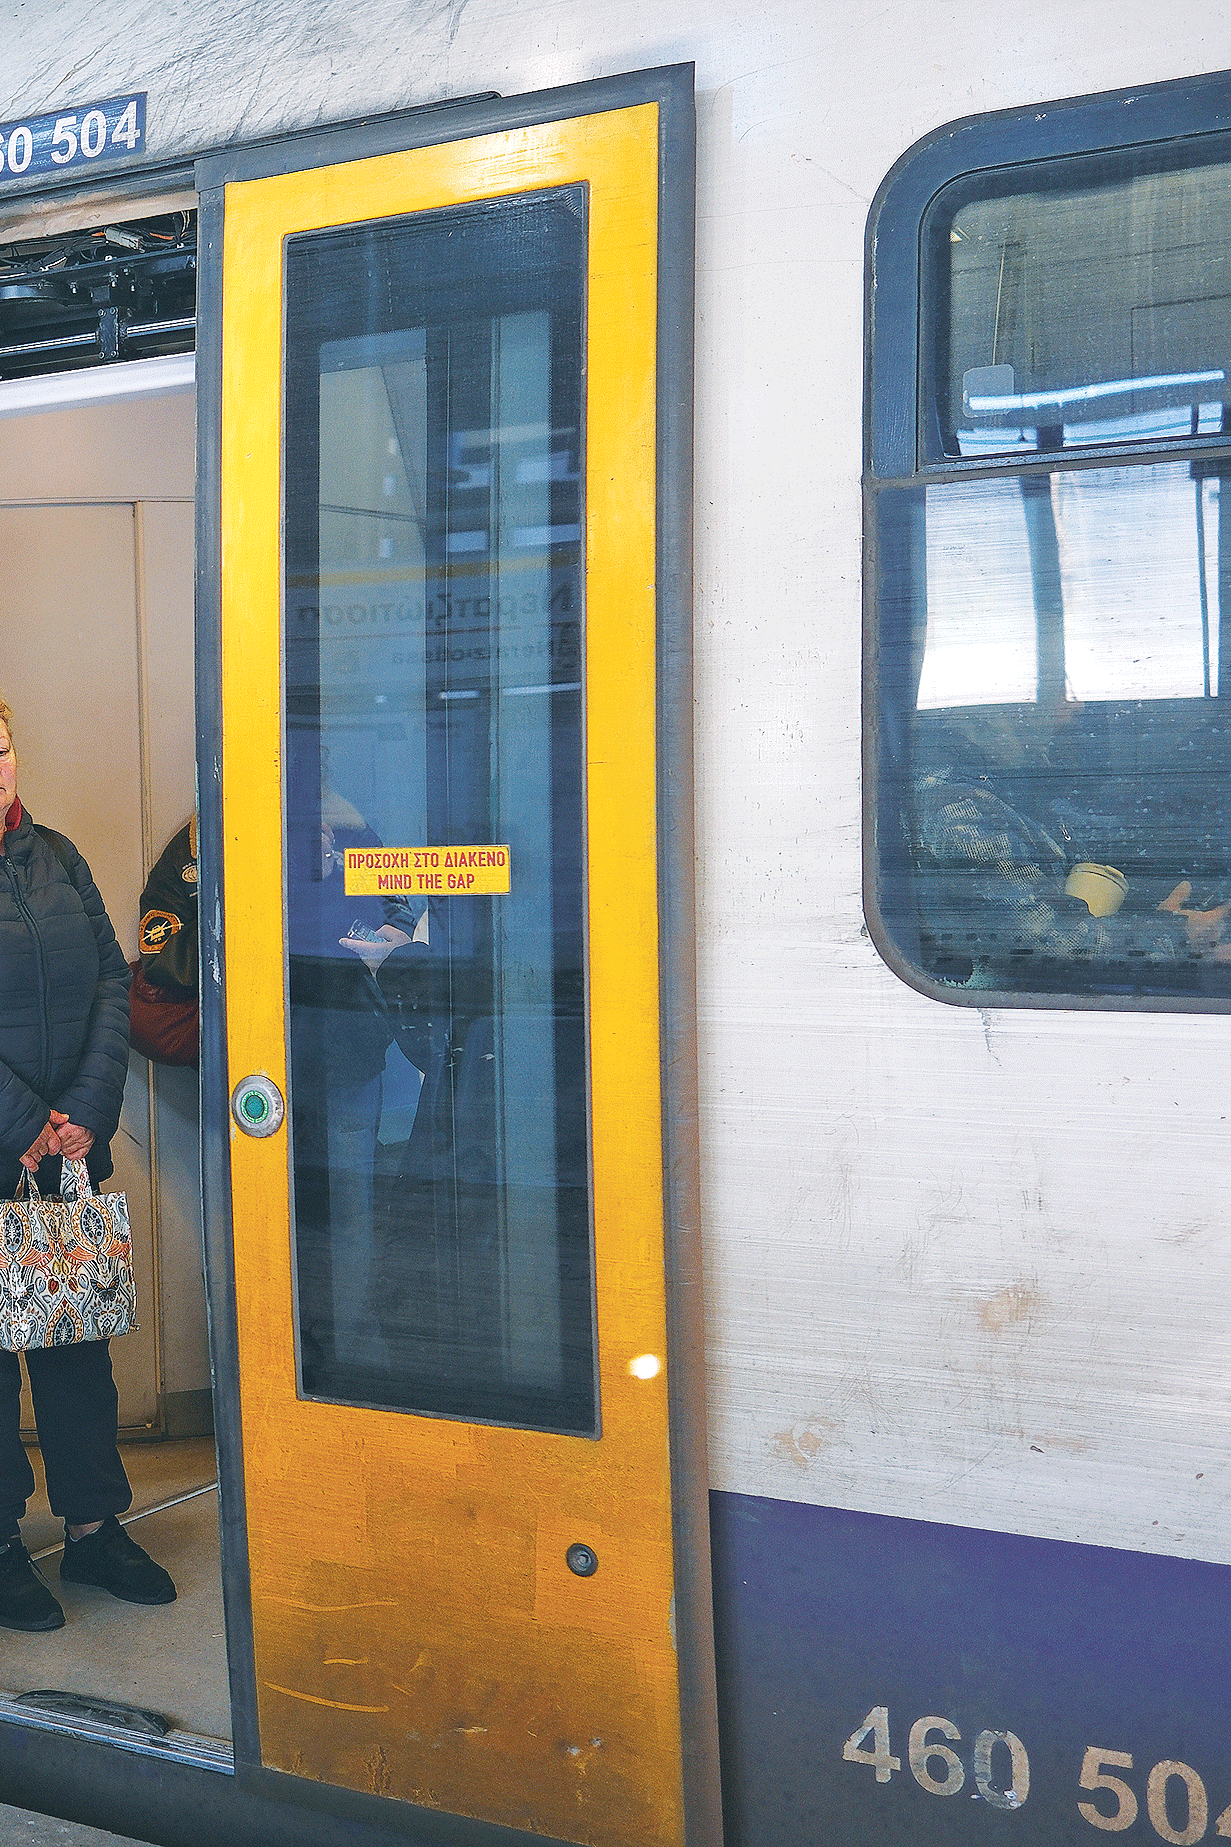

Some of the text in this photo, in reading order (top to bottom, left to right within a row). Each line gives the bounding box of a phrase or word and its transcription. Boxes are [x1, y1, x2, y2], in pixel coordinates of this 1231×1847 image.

[50, 101, 140, 164] 504
[348, 850, 506, 869] ΠΡΟΣΟΧΗ ΣΤΟ ΔΙΑΚΕΝΟ
[377, 873, 475, 889] MIND THE GAP
[842, 1705, 1231, 1847] 460 50
